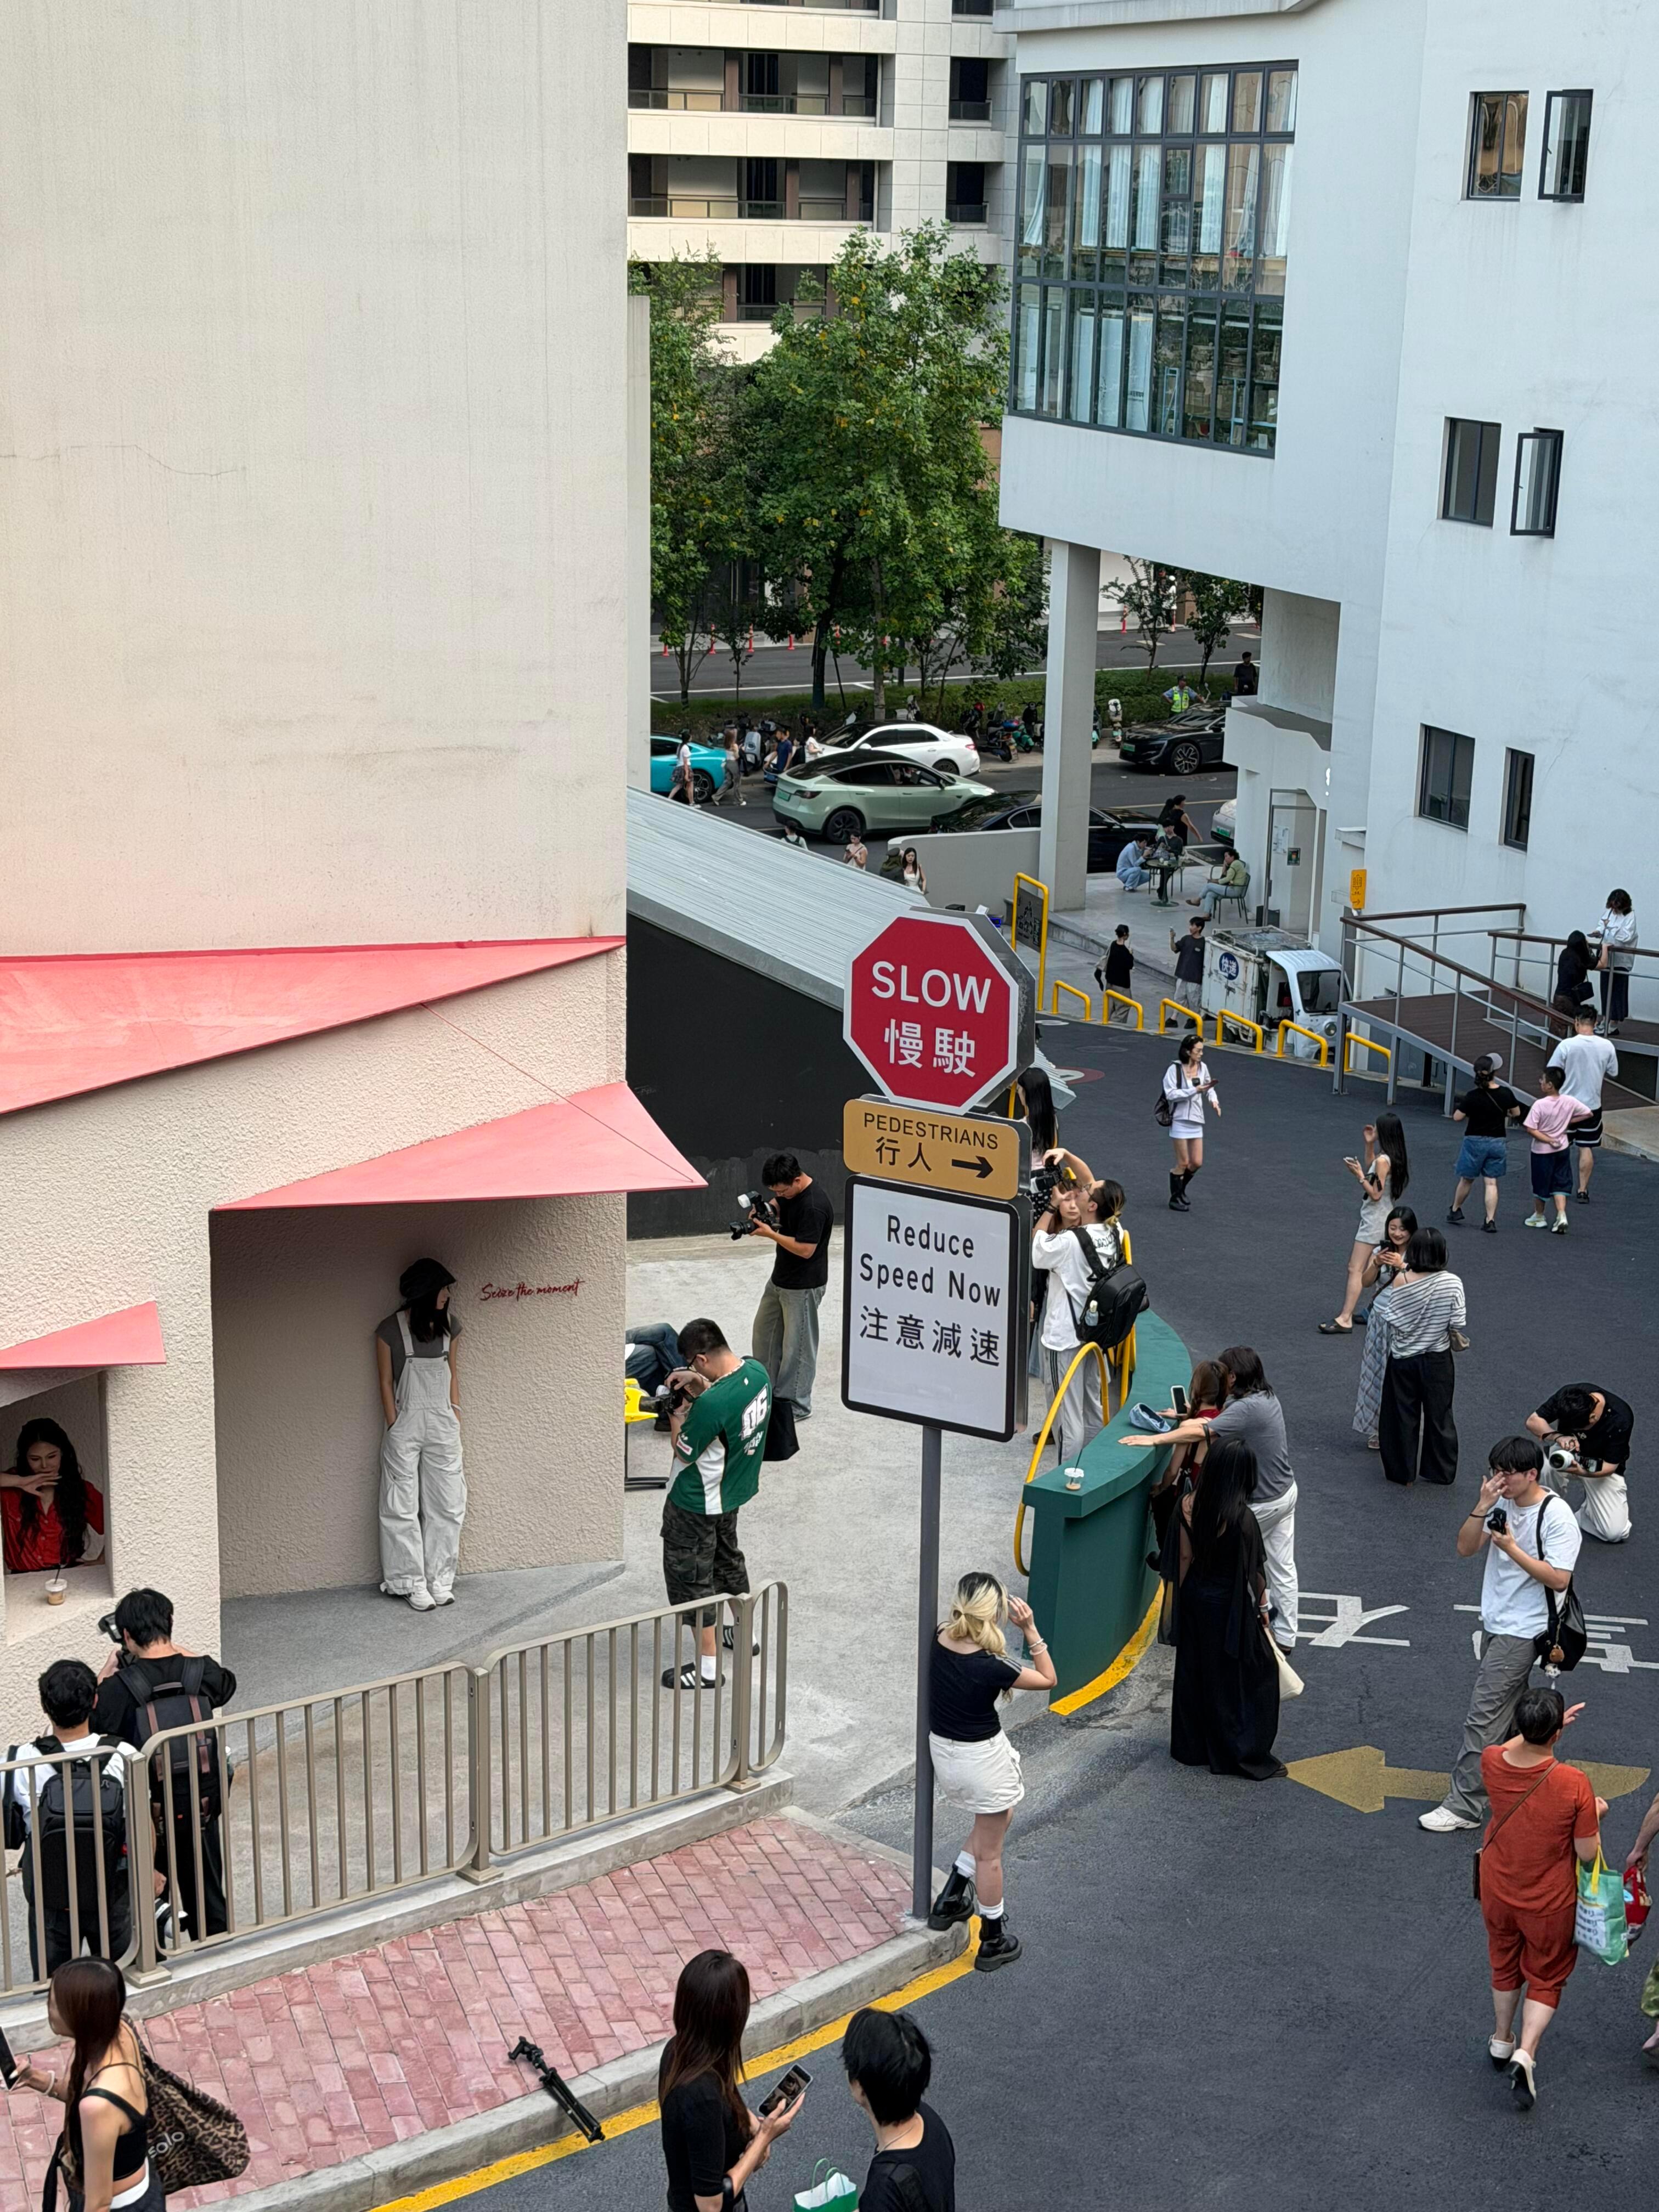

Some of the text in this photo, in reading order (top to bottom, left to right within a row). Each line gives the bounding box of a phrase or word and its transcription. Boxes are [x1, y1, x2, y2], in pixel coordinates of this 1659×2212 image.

[871, 961, 991, 1014] SLOW
[884, 1018, 975, 1077] 慢駛
[864, 1112, 998, 1149] PEDESTRIANS
[876, 1137, 932, 1172] 行人
[887, 1214, 974, 1259] Reduce
[480, 1277, 585, 1301] Seize the moment
[860, 1253, 1001, 1307] Speed Now
[860, 1306, 1001, 1367] 注意減速
[148, 2131, 185, 2158] solo
